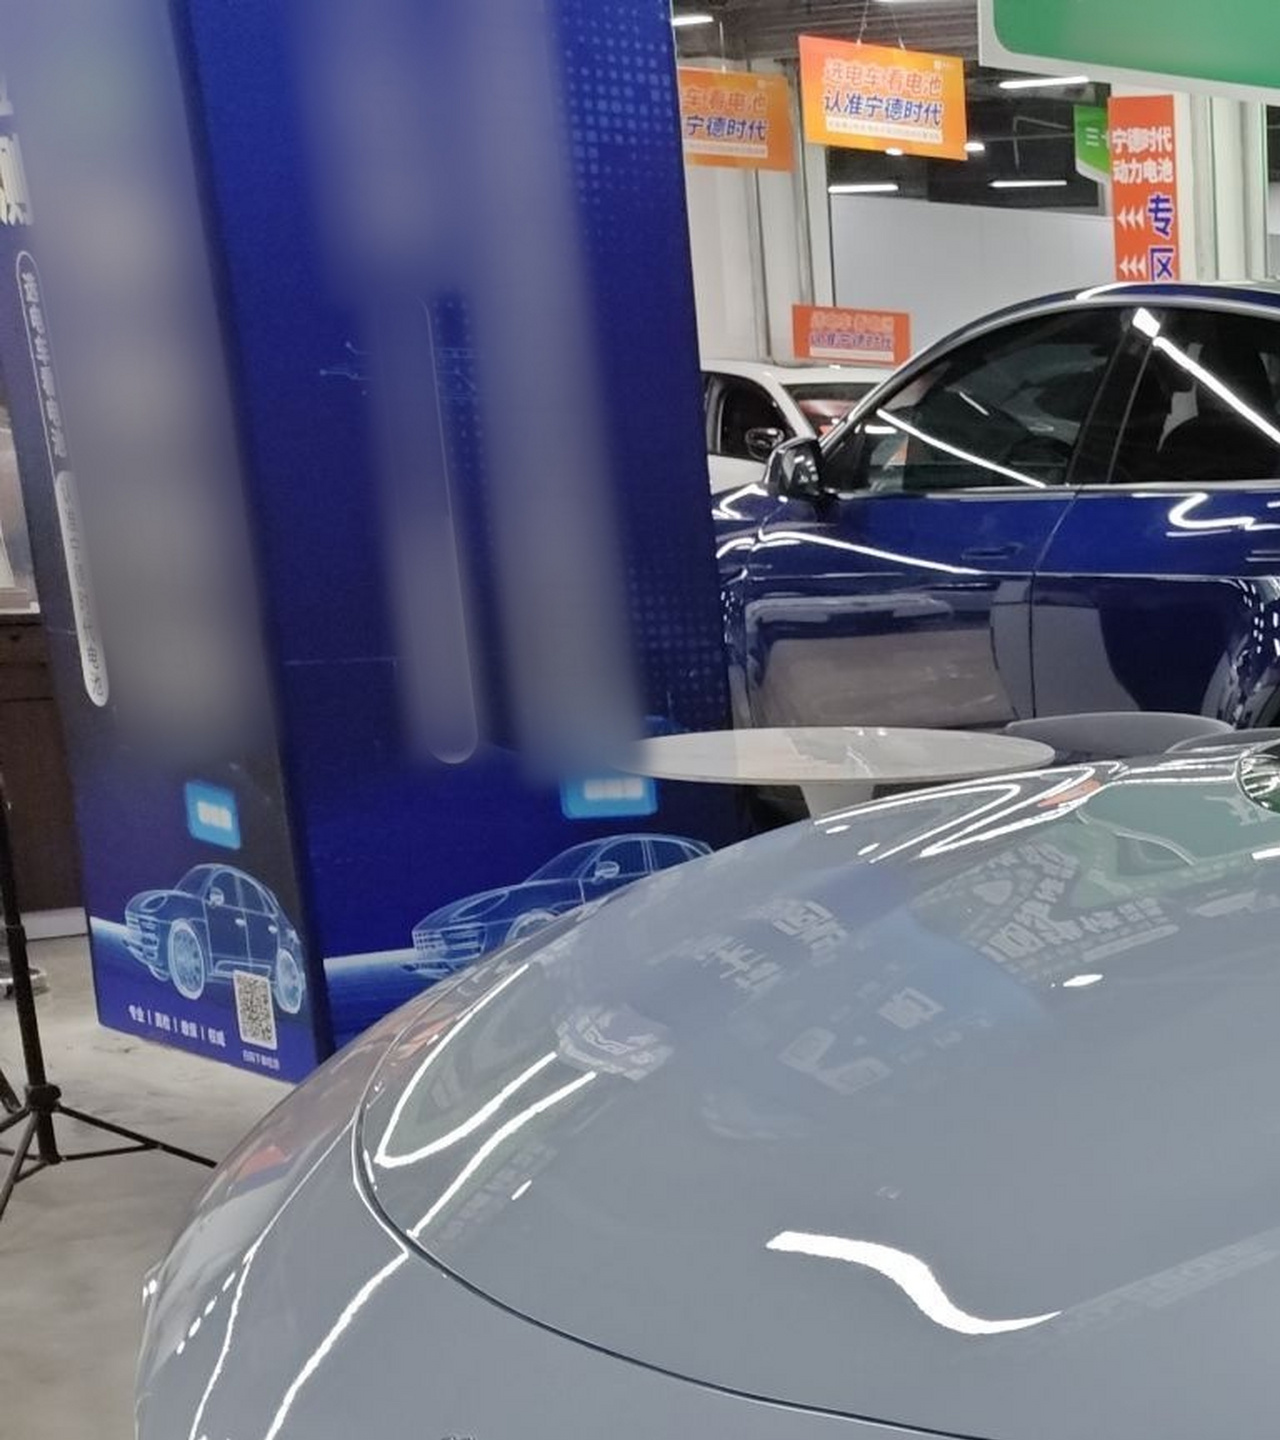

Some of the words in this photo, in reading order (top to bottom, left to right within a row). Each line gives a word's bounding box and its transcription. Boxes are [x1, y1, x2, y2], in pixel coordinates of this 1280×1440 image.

[825, 90, 943, 126] 认准宁德时代
[687, 115, 767, 141] 宁德时代
[1111, 126, 1173, 154] 宁德时代
[1112, 157, 1174, 184] 动力电池
[1148, 193, 1174, 281] 专区
